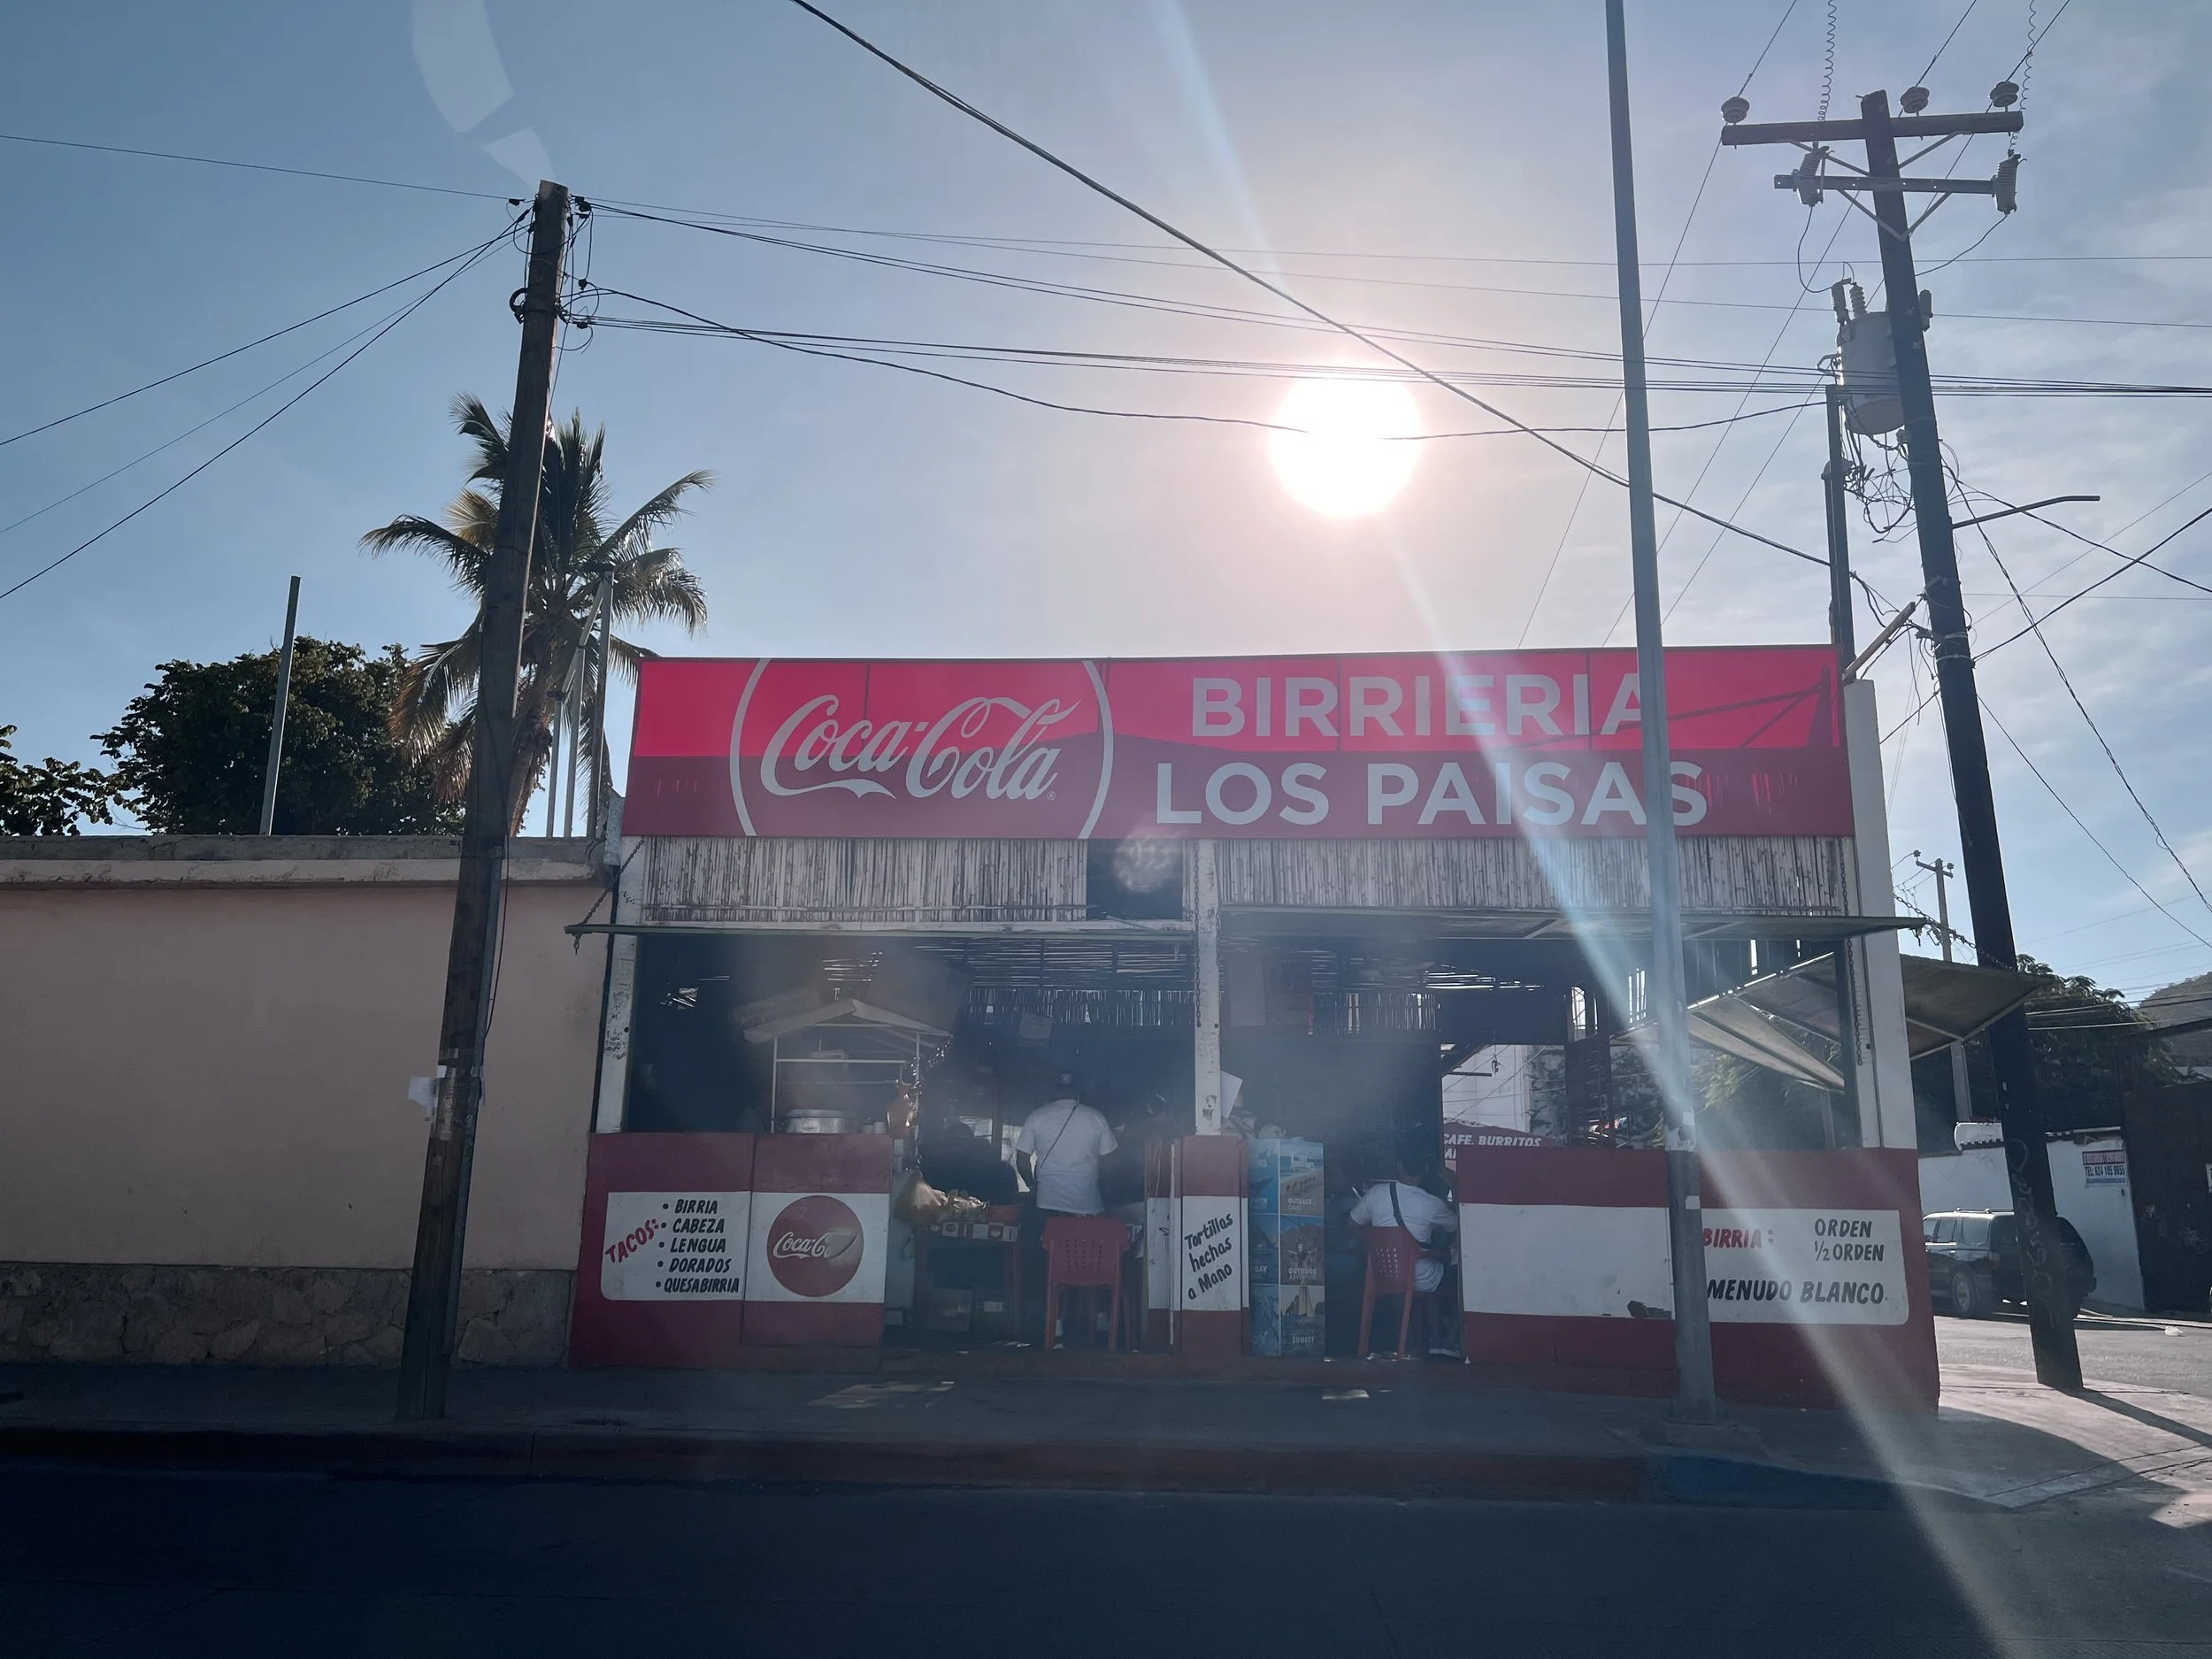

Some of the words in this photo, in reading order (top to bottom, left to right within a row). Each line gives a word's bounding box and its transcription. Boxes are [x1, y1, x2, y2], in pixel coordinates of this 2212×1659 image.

[1192, 673, 1644, 737] BIRRIERIA
[760, 694, 1081, 801] Coca-Cola
[1156, 761, 1329, 826] LOS
[1367, 761, 1708, 826] PAISAS
[1478, 1135, 1541, 1147] BURRITOS
[674, 1199, 718, 1214] BIRRIA
[672, 1217, 725, 1233] CABEZA
[1184, 1213, 1233, 1249] Tortillas
[1815, 1218, 1872, 1239] ORDEN
[604, 1218, 659, 1263] TACOS:
[670, 1237, 726, 1253] LENGUA
[1188, 1237, 1233, 1273] hechas
[1832, 1243, 1885, 1262] ORDEN
[668, 1257, 732, 1273] DORADOS
[664, 1277, 740, 1294] QUESABIRRIA
[1187, 1287, 1197, 1301] a
[1197, 1263, 1233, 1294] Mano
[1707, 1279, 1793, 1302] MENUDO
